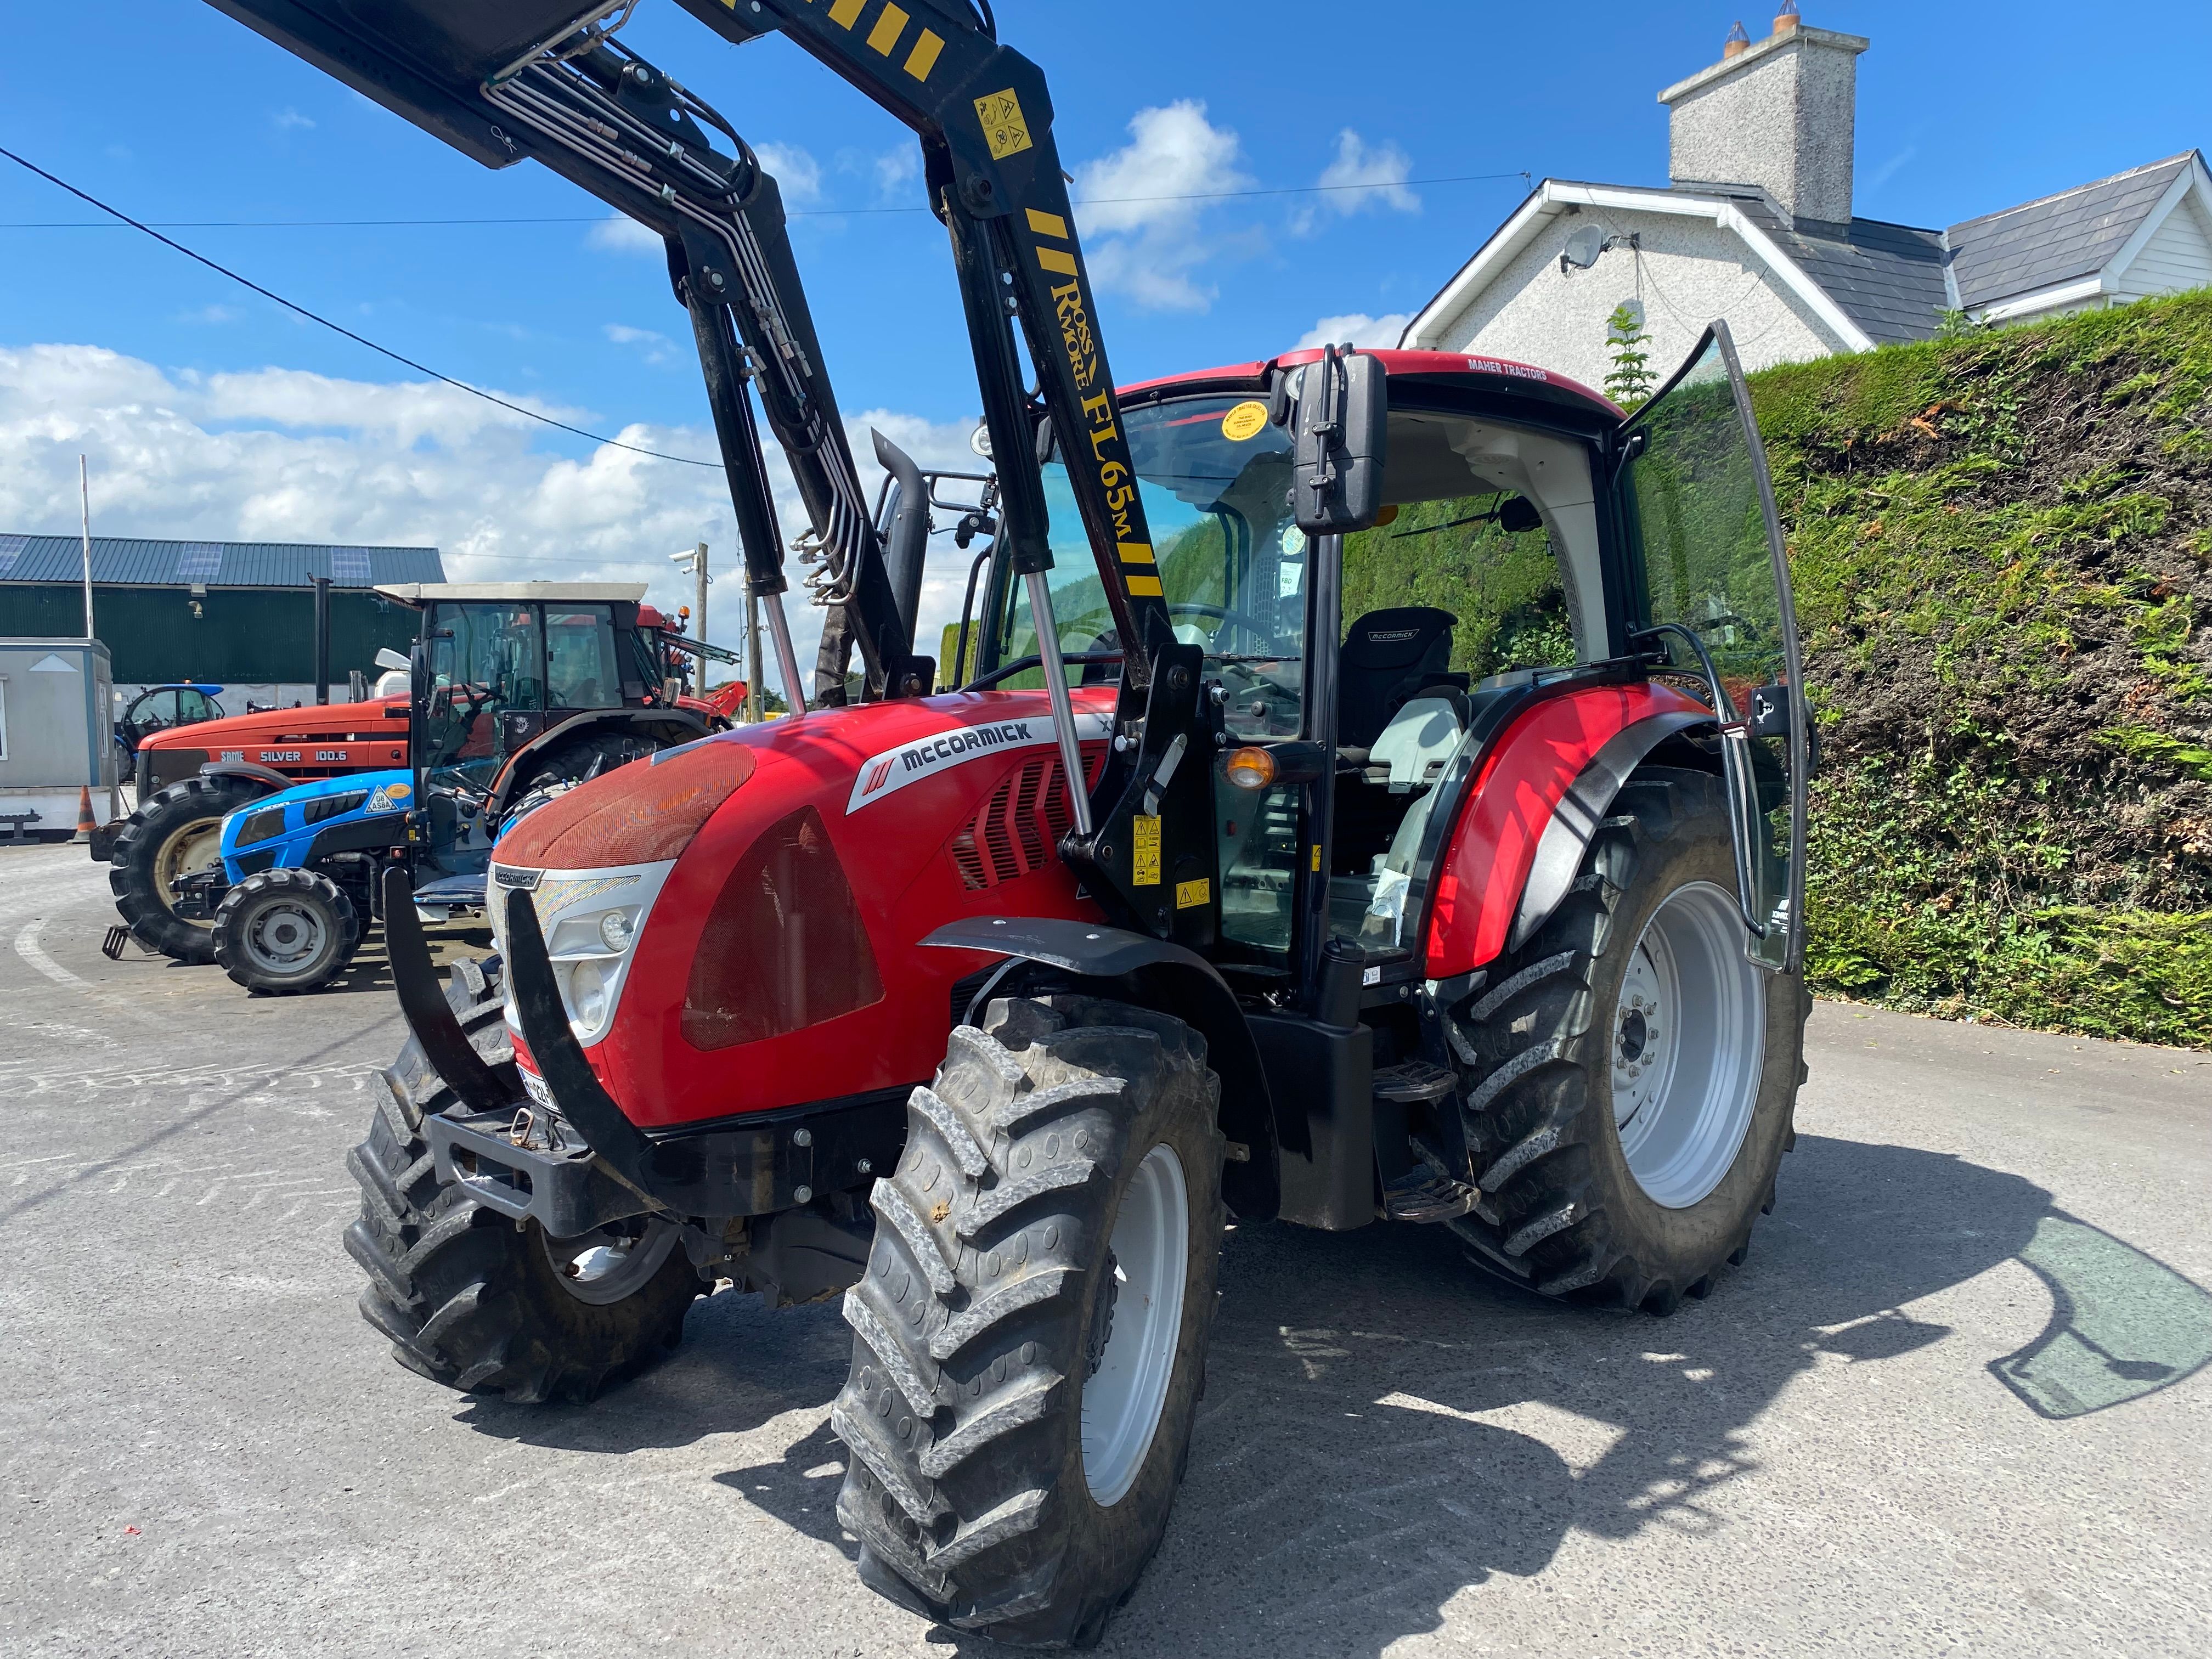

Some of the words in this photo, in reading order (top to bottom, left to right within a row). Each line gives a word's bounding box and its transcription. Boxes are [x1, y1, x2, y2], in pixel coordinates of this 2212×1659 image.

[1468, 359, 1502, 373] MAHER
[1503, 364, 1547, 380] TRACTORS
[221, 751, 245, 762] SAME
[260, 751, 302, 762] SILVER
[315, 751, 347, 761] 100.6
